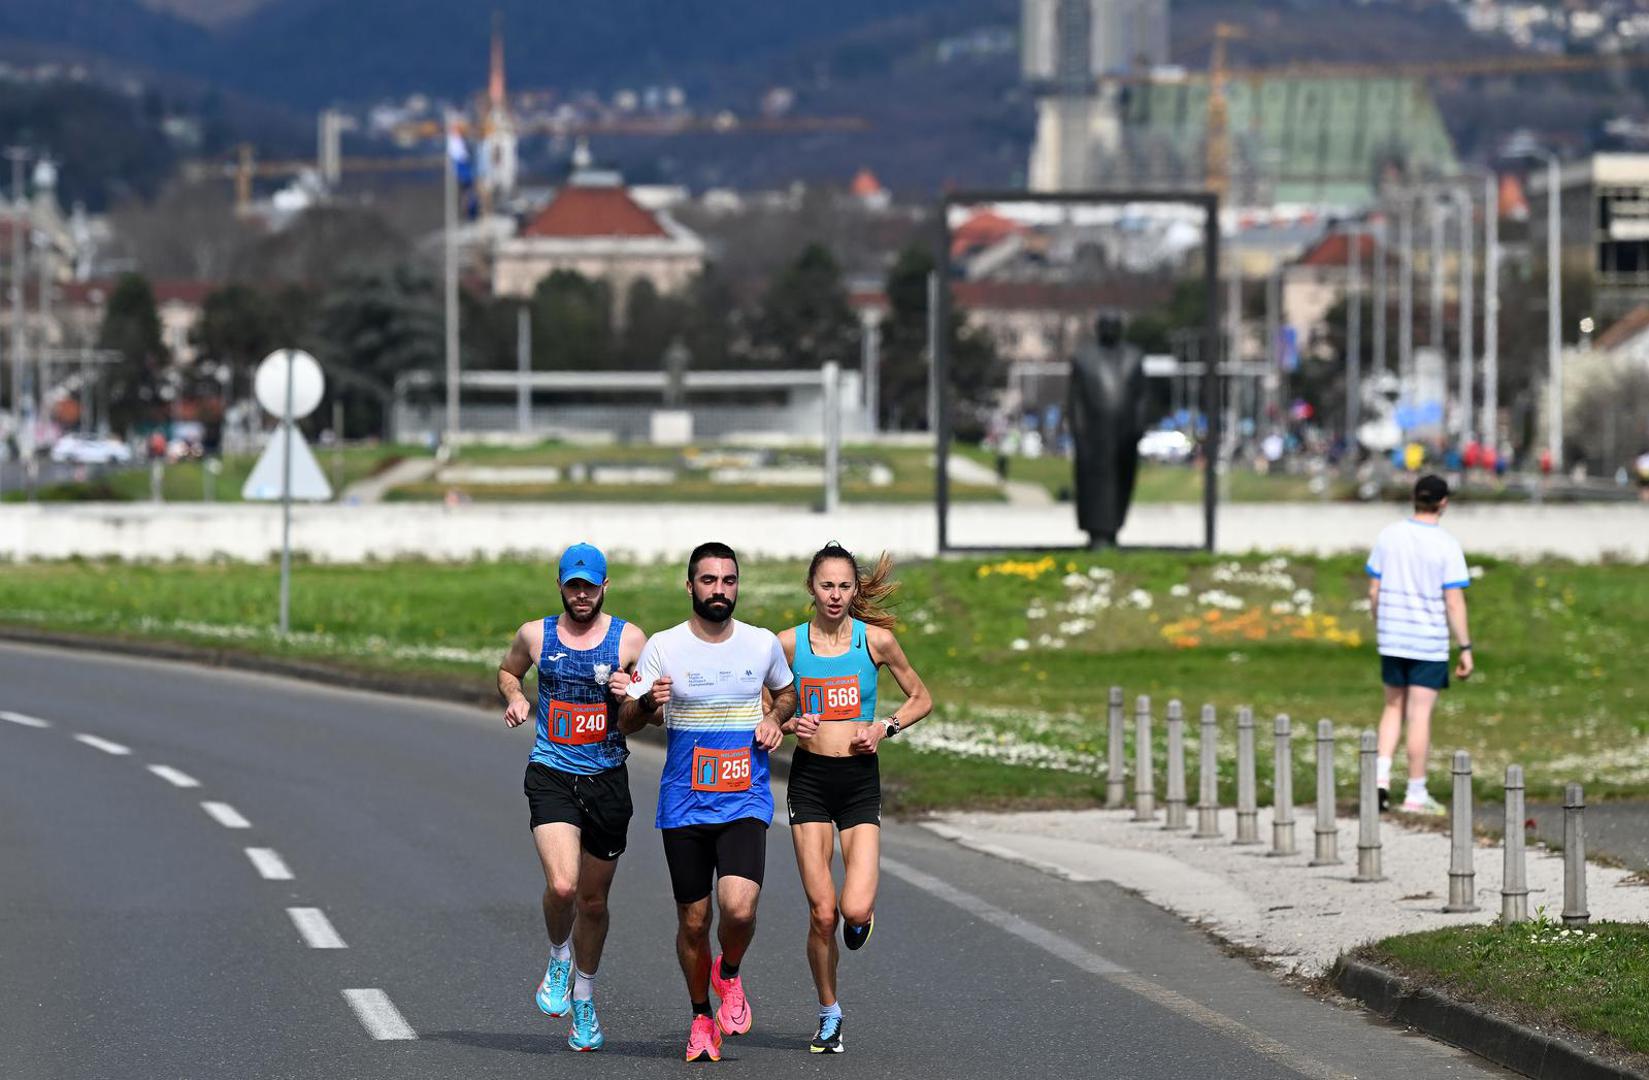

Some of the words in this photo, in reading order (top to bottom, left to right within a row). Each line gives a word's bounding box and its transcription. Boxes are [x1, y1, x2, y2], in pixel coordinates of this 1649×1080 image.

[827, 686, 859, 708] 568
[575, 713, 605, 733] 240
[721, 758, 750, 780] 255
